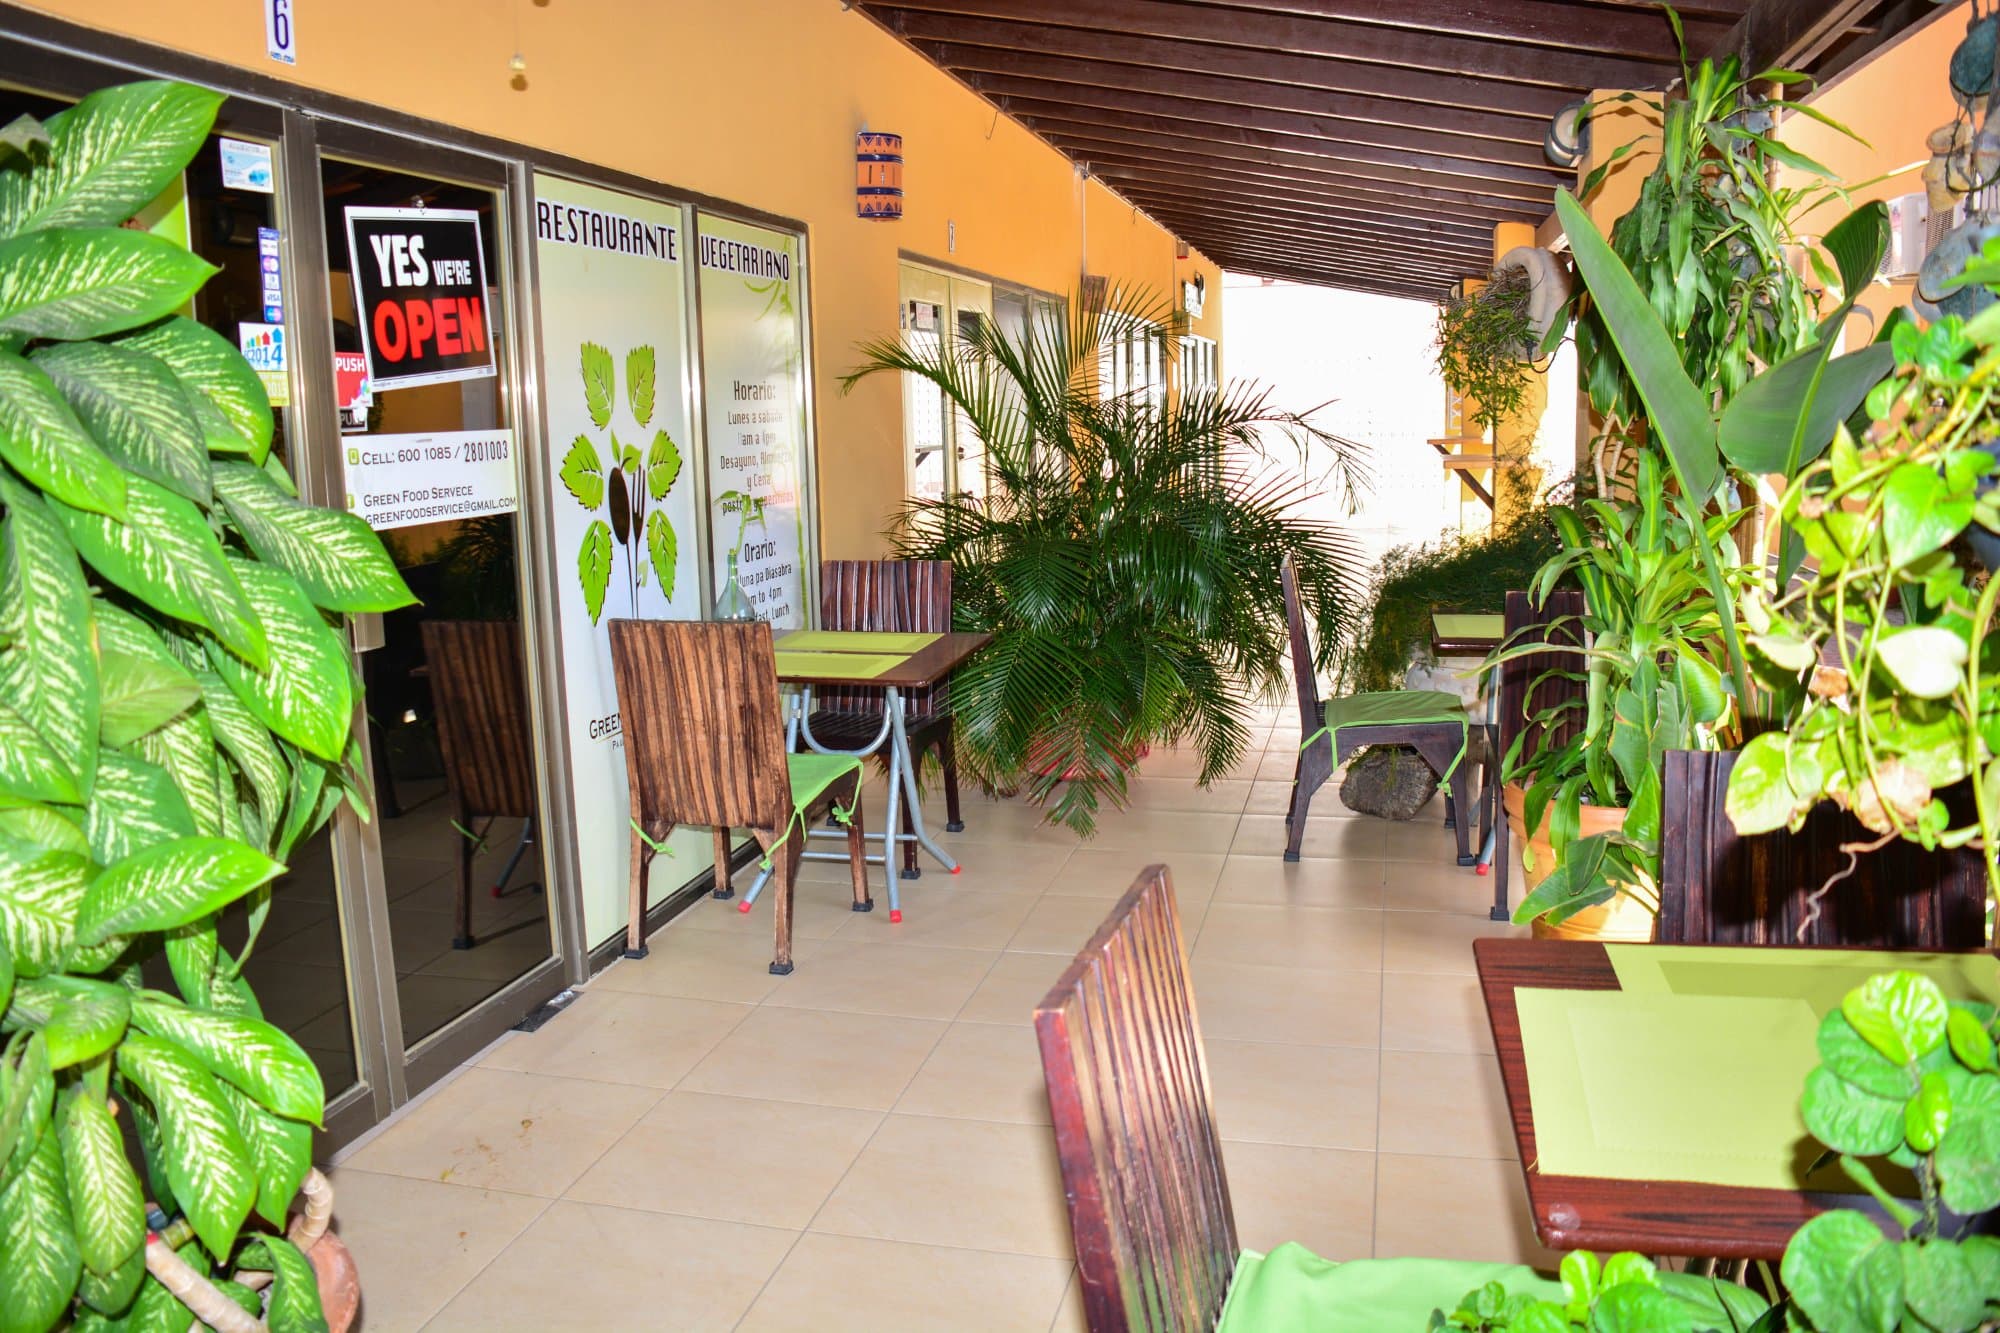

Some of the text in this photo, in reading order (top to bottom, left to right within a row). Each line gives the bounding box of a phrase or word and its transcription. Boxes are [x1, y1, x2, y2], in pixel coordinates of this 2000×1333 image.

[273, 0, 289, 50] 6
[537, 201, 790, 280] RESTAURANTE VEGETARIANO
[369, 235, 472, 287] YES WE'RE
[374, 296, 485, 362] OPEN
[335, 357, 365, 373] PUSH
[733, 380, 776, 401] Horario:
[728, 411, 750, 425] Lunes
[362, 450, 395, 465] CELL:
[398, 449, 420, 463] 600
[426, 446, 451, 460] 1085
[464, 440, 508, 462] 2801003
[363, 486, 473, 508] GREEN FOOD SERVECE
[744, 539, 776, 563] Orario:
[756, 571, 763, 585] pa
[759, 590, 765, 603] to
